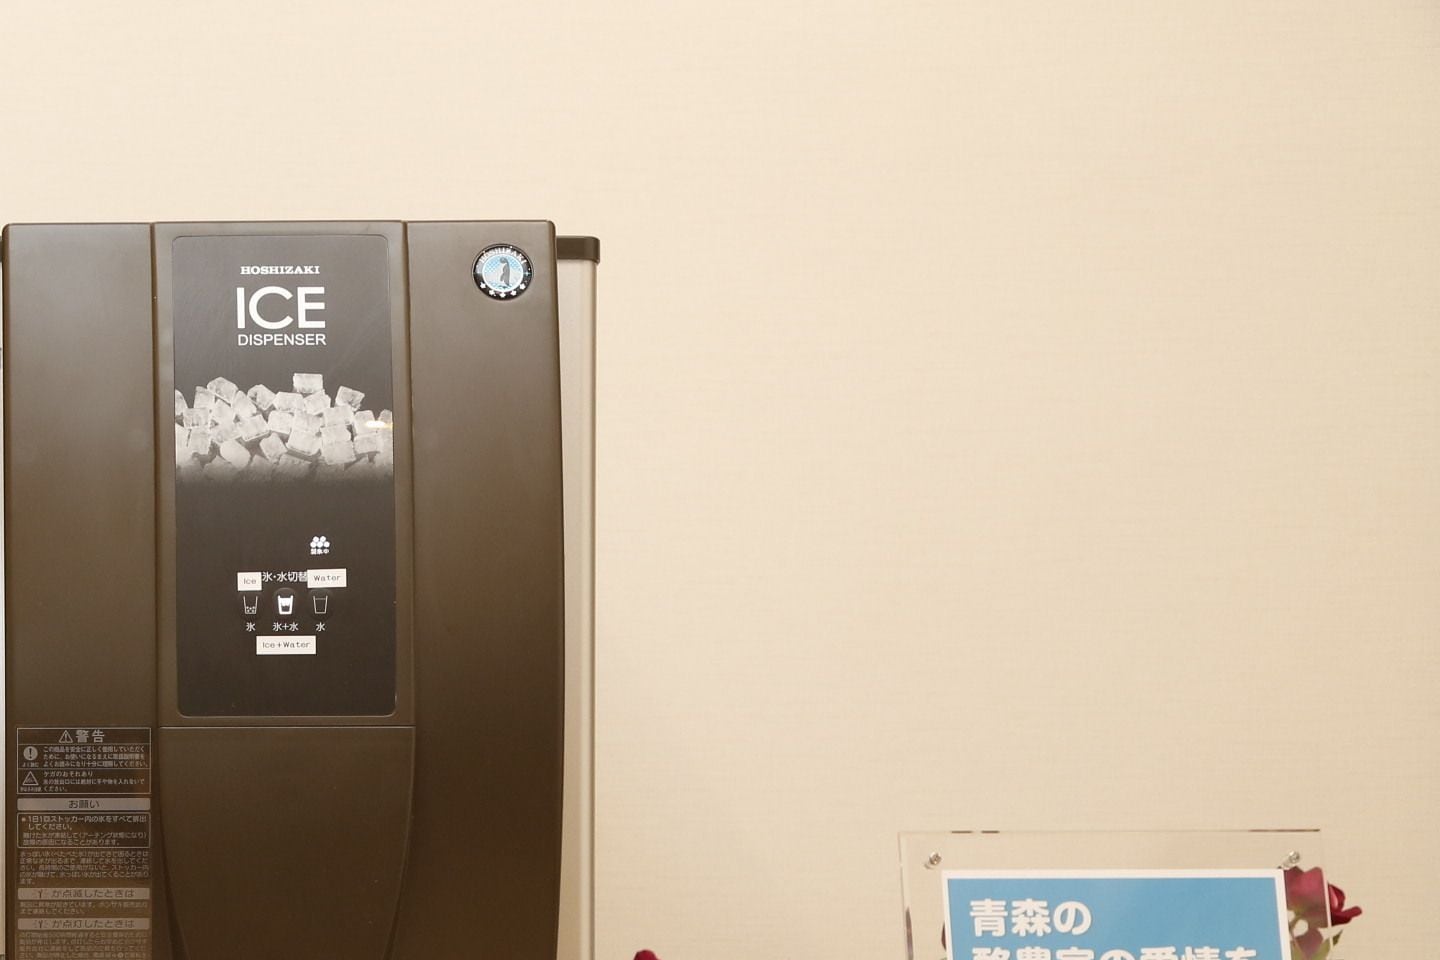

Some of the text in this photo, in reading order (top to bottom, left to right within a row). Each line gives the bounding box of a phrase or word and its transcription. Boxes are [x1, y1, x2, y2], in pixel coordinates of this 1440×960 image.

[240, 265, 320, 275] HOSHIZAKI
[236, 286, 326, 329] ICE
[237, 334, 327, 346] DISPENSER
[243, 577, 257, 585] Ice
[313, 574, 341, 582] Water
[246, 622, 256, 632] 氷
[315, 622, 326, 632] 水
[75, 729, 105, 743] 警告
[69, 800, 100, 809] お願い
[969, 898, 1092, 937] 青森の
